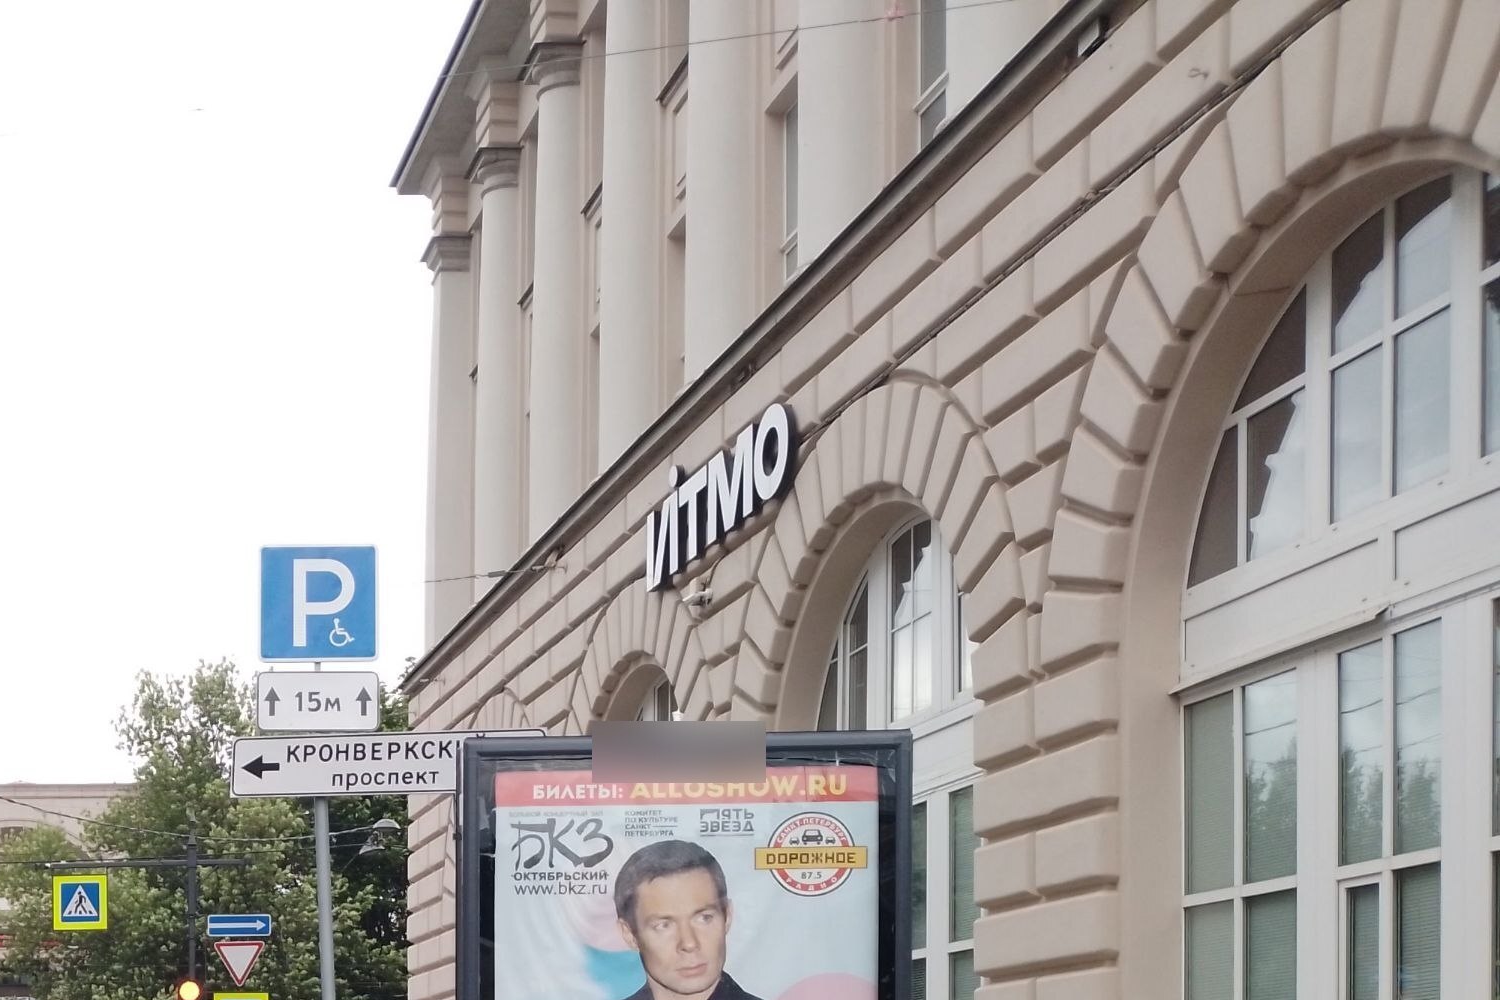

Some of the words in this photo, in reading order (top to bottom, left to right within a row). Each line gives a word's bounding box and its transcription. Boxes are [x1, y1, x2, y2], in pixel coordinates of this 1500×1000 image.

[292, 558, 355, 647] P
[295, 692, 341, 713] 15м
[286, 740, 463, 764] КРОНВЕРКСК
[331, 771, 439, 791] проспект
[532, 783, 625, 800] БИЛЕТЫ:
[510, 818, 613, 870] БКЗ
[766, 852, 856, 865] ДОРОЖНОЕ
[512, 870, 609, 881] ОКТЯБРЬСКИЙ
[786, 876, 838, 891] РАДИО
[514, 882, 608, 896] www.bkz.ru
